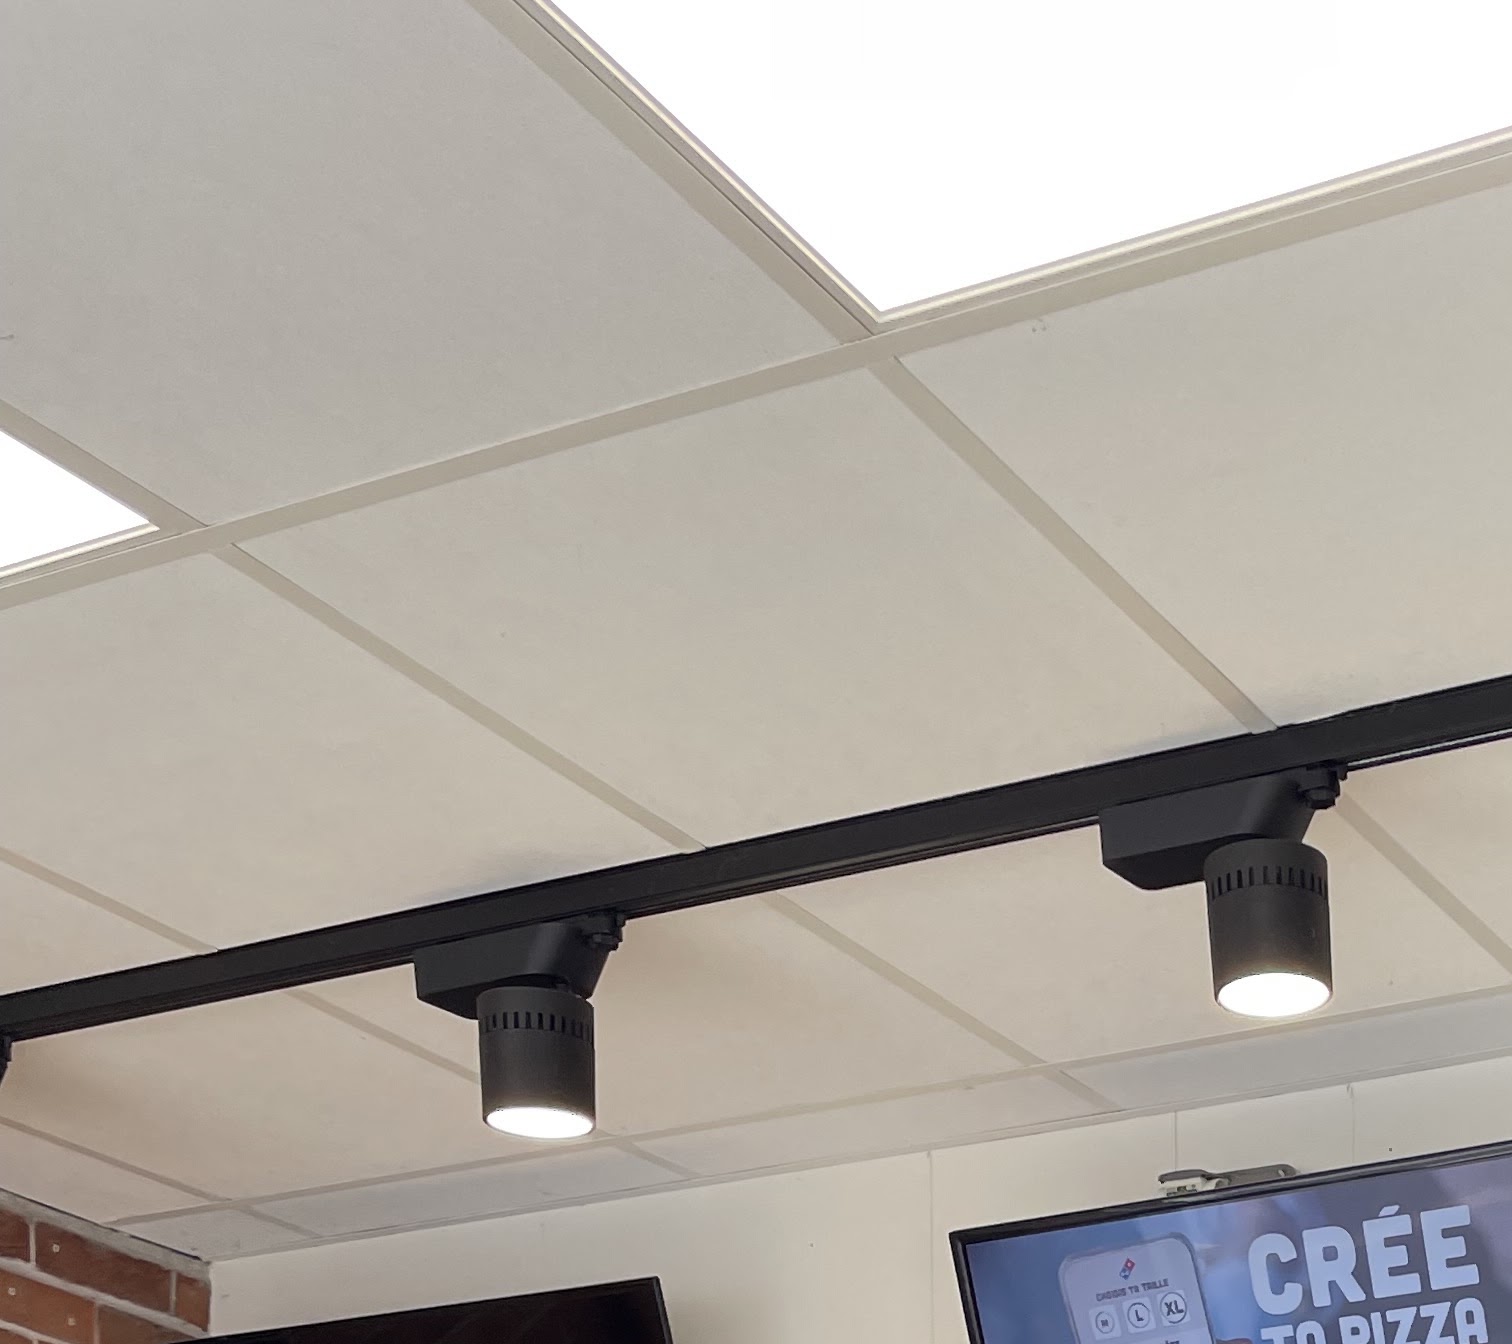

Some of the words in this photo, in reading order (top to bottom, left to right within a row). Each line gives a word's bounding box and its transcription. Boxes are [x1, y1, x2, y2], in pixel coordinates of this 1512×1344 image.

[1248, 1205, 1480, 1315] CRÉE
[1135, 1309, 1143, 1322] L
[1164, 1300, 1184, 1316] XL
